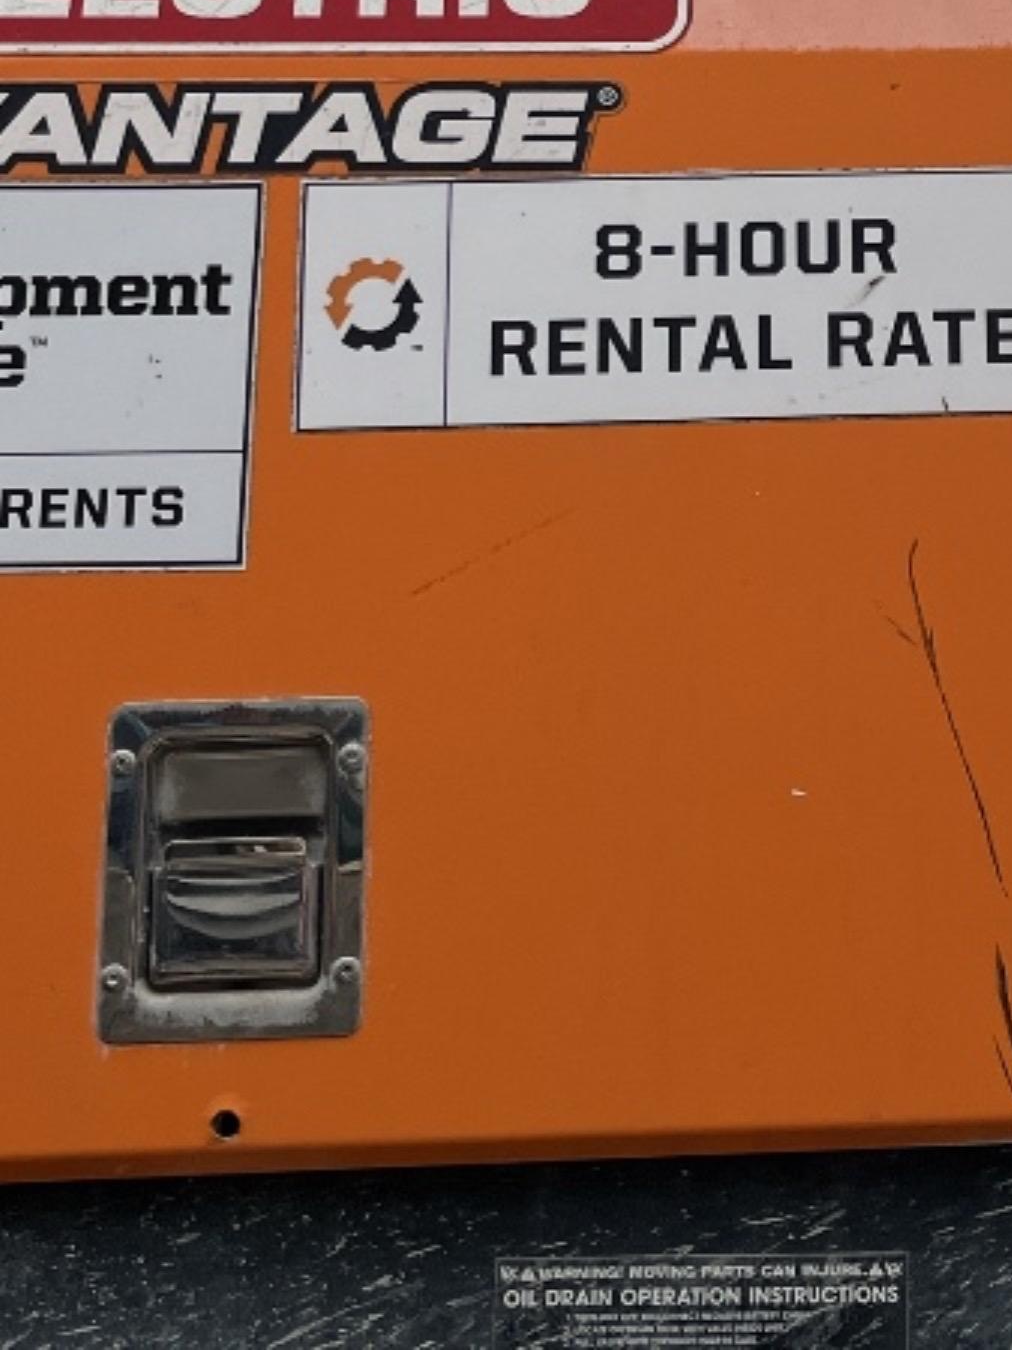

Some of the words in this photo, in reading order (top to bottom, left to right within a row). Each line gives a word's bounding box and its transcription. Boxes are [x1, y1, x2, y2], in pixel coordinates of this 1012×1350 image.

[595, 217, 898, 280] 8-HOUR
[489, 313, 794, 377] RENTAL
[0, 485, 185, 529] RENTS
[701, 1264, 756, 1279] PARTS
[761, 1264, 796, 1278] CAN
[503, 1288, 538, 1308] OIL
[545, 1288, 613, 1307] DRAIN
[620, 1286, 741, 1307] OPERATION
[749, 1285, 899, 1305] INSTRUCTIONS
